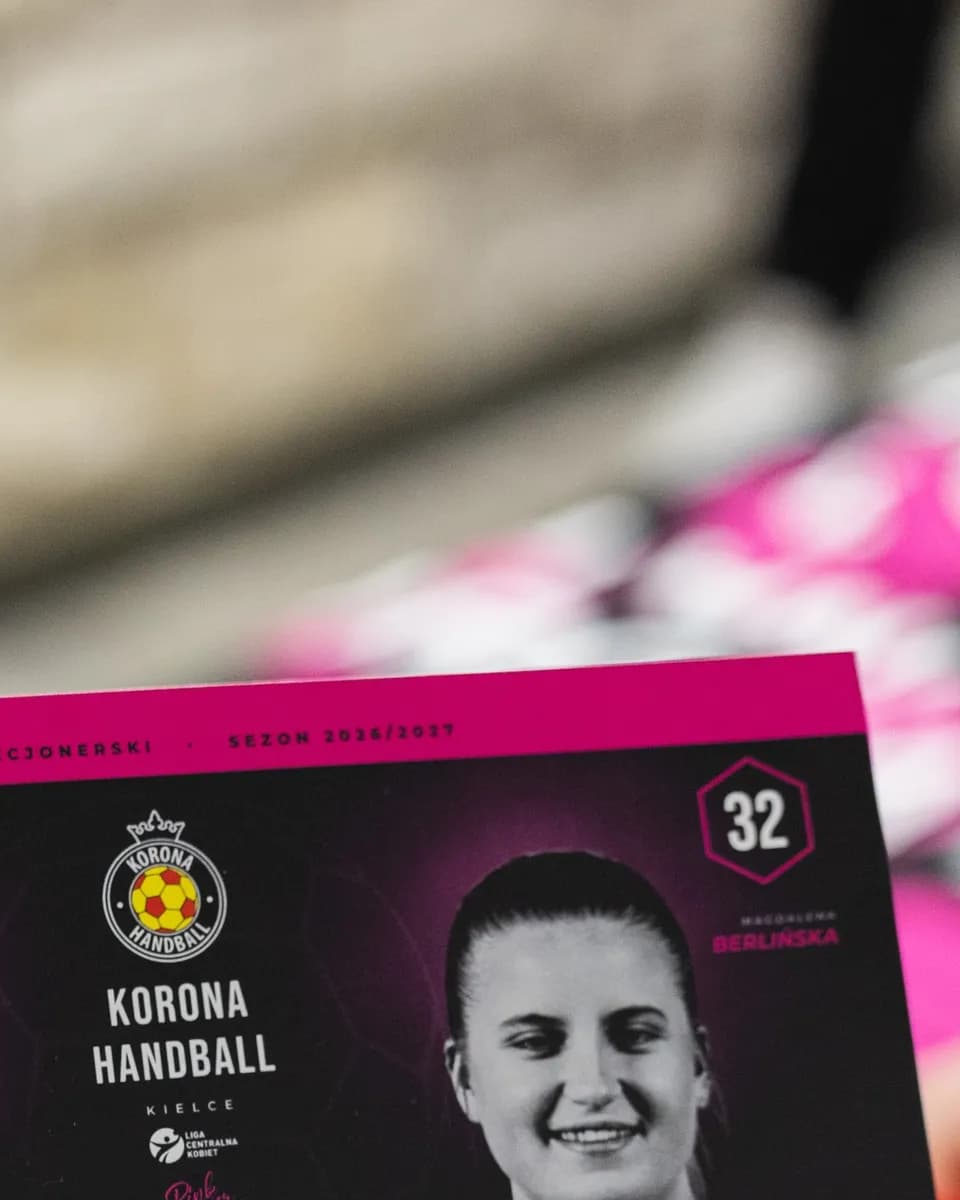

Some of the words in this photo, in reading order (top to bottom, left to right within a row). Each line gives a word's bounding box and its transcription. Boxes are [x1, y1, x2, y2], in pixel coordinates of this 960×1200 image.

[229, 732, 309, 748] SEZON
[324, 723, 454, 743] 2026/2027
[723, 789, 789, 852] 32
[126, 846, 194, 873] KORONA
[128, 922, 212, 954] HANDBALL
[107, 979, 249, 1027] KORONA
[92, 1033, 277, 1085] HANDBALL
[146, 1099, 235, 1117] KIELCE
[184, 1130, 206, 1140] LIGA
[185, 1137, 239, 1149] CENTRALNA
[187, 1148, 218, 1159] KOBIET
